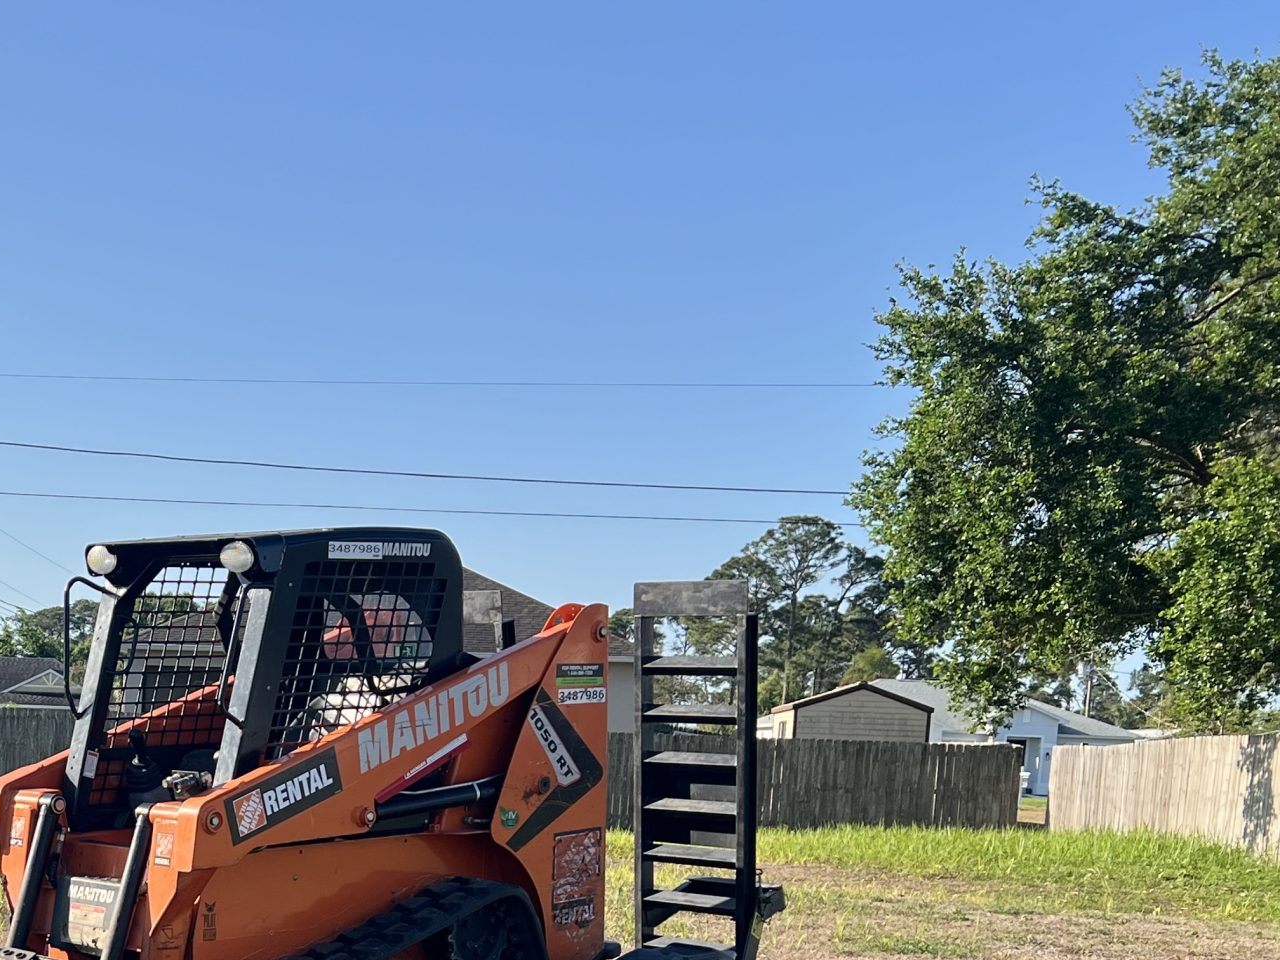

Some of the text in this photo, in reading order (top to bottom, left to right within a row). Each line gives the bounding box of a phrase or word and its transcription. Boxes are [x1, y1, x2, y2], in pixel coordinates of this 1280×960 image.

[328, 544, 380, 553] 3487986
[382, 543, 431, 556] MANITOU
[559, 690, 605, 701] 3487986
[358, 661, 509, 775] MANITOU
[530, 709, 574, 777] 1050 RT
[263, 763, 334, 816] RENTAL
[67, 885, 115, 904] MANITOU
